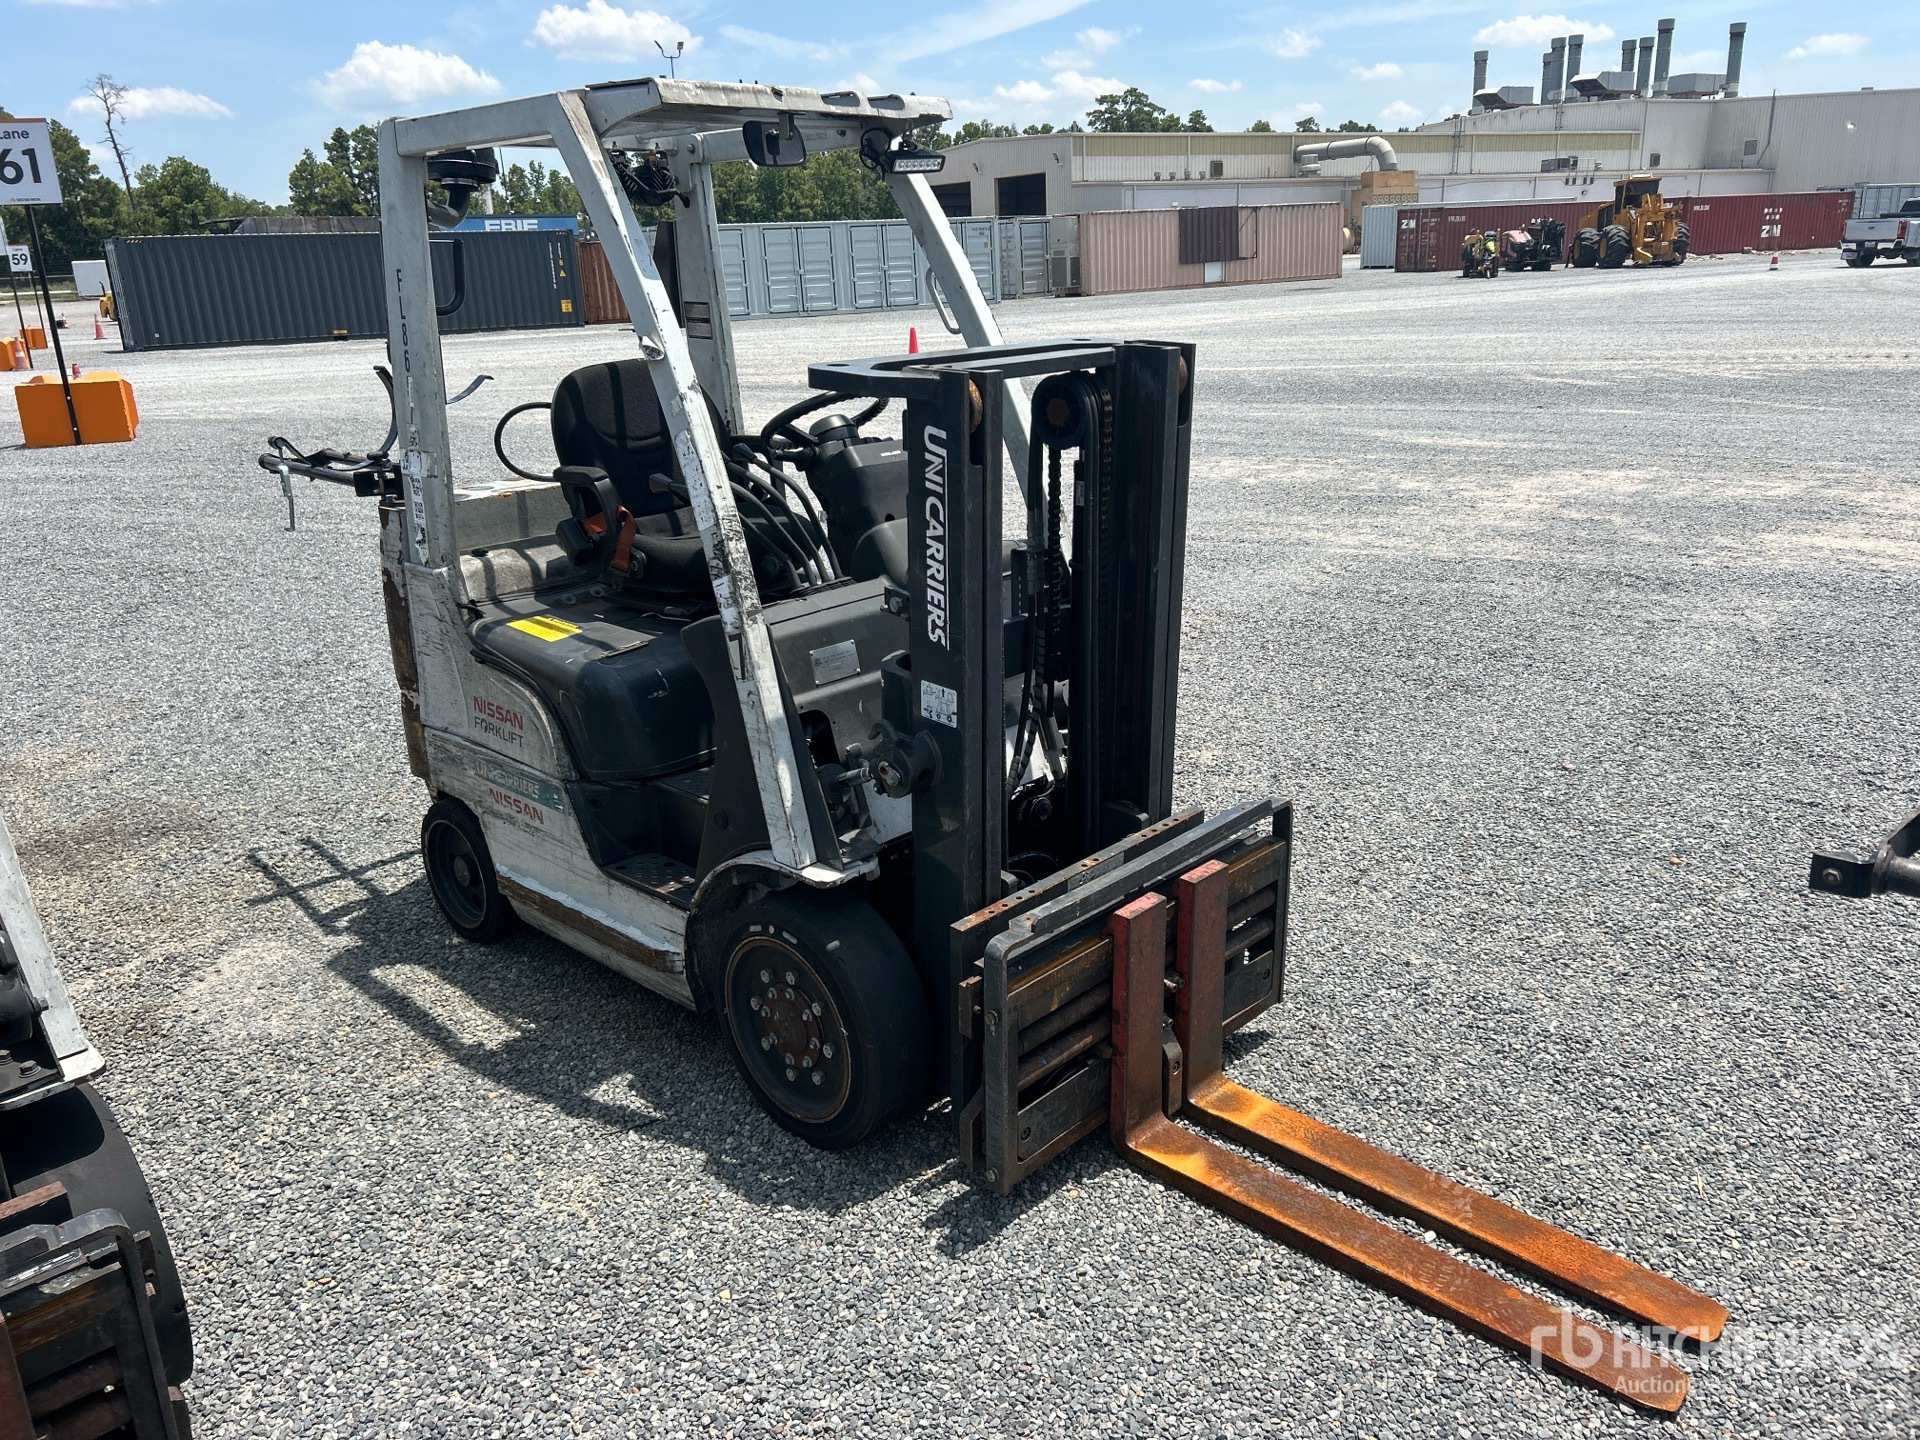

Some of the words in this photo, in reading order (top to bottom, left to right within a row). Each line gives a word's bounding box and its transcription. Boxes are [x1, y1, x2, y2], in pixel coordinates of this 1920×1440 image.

[0, 147, 42, 185] 61
[1401, 219, 1416, 229] ZM
[11, 252, 28, 266] 59
[473, 696, 524, 731] NISSAN
[474, 716, 524, 748] FORKLIFT
[488, 787, 545, 825] NISSAN
